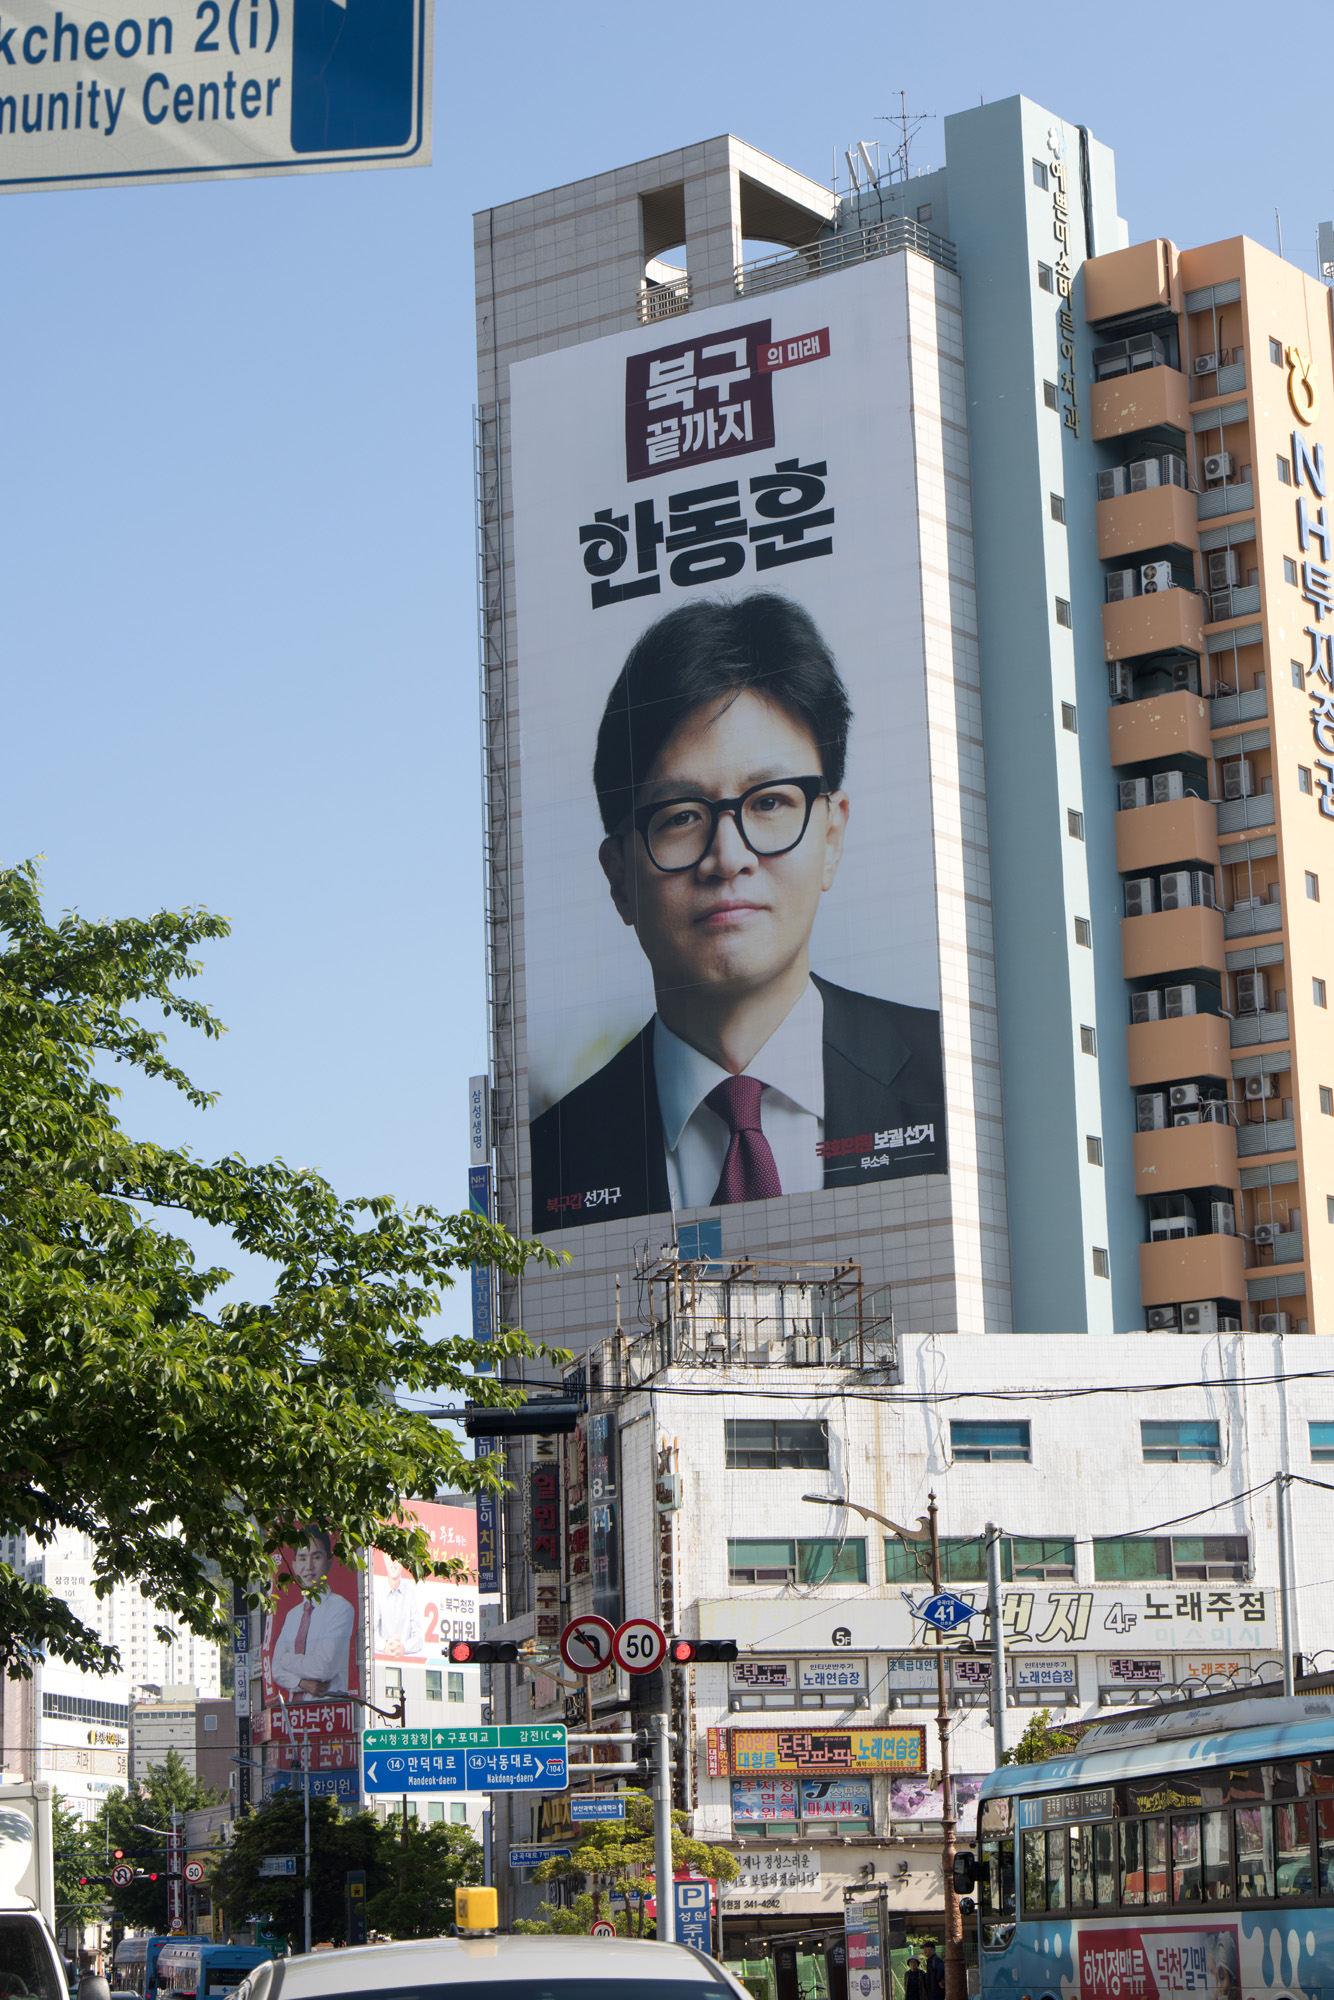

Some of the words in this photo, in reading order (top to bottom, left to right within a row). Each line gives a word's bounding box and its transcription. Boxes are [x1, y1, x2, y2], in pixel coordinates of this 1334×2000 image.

[142, 71, 282, 125] Center
[767, 346, 783, 366] 의
[787, 335, 821, 361] 미래
[646, 337, 751, 411] 북구
[646, 400, 753, 465] 끝까지
[579, 457, 835, 610] 한동훈
[472, 1089, 482, 1149] 삼성생명
[815, 1133, 874, 1159] 국회의원
[861, 1153, 890, 1169] 무소속
[471, 1175, 486, 1183] NH
[546, 1193, 583, 1213] 북구갑
[584, 1187, 621, 1208] 선거구
[534, 1473, 556, 1560] 일번지
[55, 1576, 86, 1586] 삼경장미
[445, 1598, 474, 1614] 북구청장
[537, 1586, 558, 1637] 주점
[934, 1605, 955, 1621] 41
[1143, 1591, 1266, 1622] 노래주점
[423, 1602, 440, 1644] 2
[1103, 1602, 1137, 1633] 4F
[439, 1619, 476, 1642] 오태원
[835, 1632, 852, 1646] 5F
[626, 1634, 654, 1659] 50
[889, 1659, 914, 1672] 초특급
[1110, 1659, 1165, 1682] 돈텔파파
[1188, 1662, 1240, 1677] 노래주점
[733, 1663, 791, 1687] 돈텔파파
[803, 1672, 860, 1686] 노래연습장
[1019, 1670, 1074, 1684] 노래연습장
[272, 1705, 351, 1735] 대한보청기
[447, 1732, 489, 1743] 구포대교
[519, 1730, 550, 1742] 감전IC
[737, 1734, 776, 1751] 60인실
[778, 1735, 857, 1767] 돈텔파파
[857, 1737, 920, 1760] 노래연습장
[407, 1756, 456, 1772] 만덕대로
[487, 1754, 533, 1771] 낙동대로
[549, 1765, 562, 1773] 104
[738, 1752, 776, 1769] 대형룸
[408, 1775, 457, 1786] Mandeok-daero
[486, 1773, 534, 1784] Nakdong-daero
[741, 1780, 796, 1793] 주차장
[314, 1779, 351, 1796] 한의원
[805, 1781, 841, 1800] J
[830, 1786, 868, 1798] 스포츠
[807, 1801, 853, 1816] 마사지
[853, 1803, 867, 1815] 2F
[1024, 1801, 1037, 1825] 111
[764, 1853, 810, 1870] 정성스러운
[188, 1867, 199, 1877] 50
[683, 1887, 702, 1906] P
[679, 1911, 707, 1923] 성원
[1083, 1948, 1146, 1996] 하지정맥류
